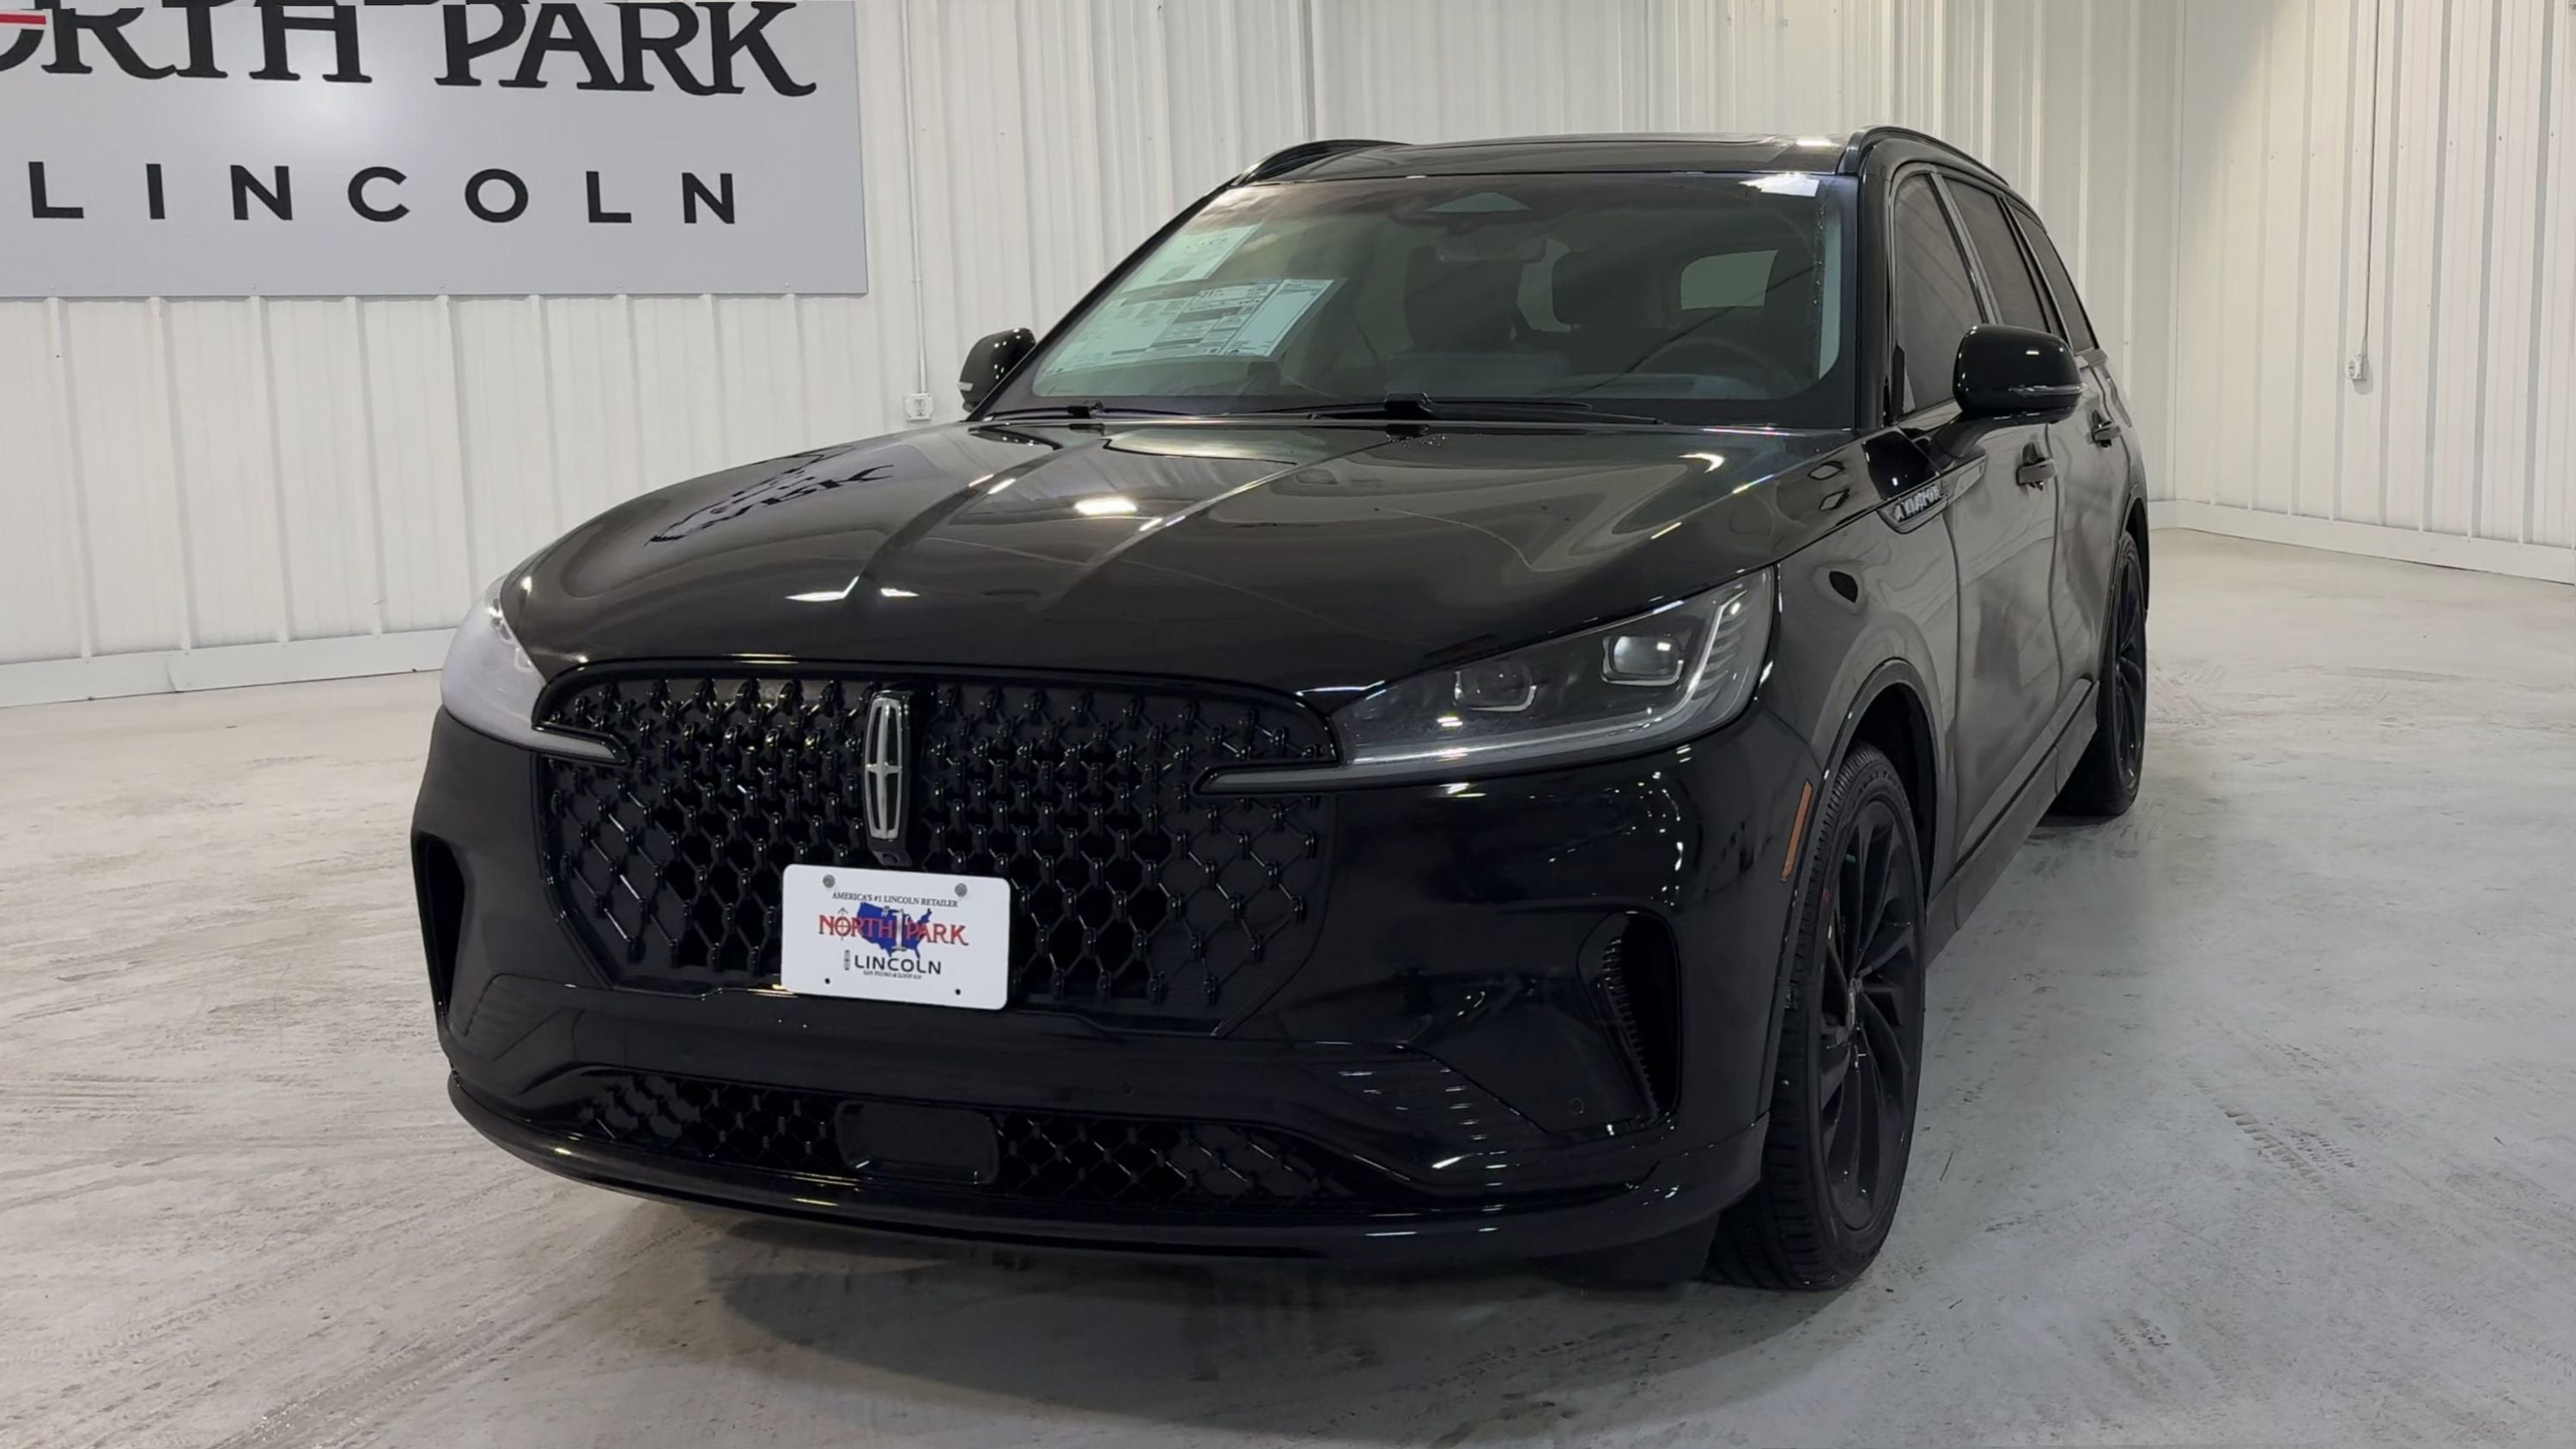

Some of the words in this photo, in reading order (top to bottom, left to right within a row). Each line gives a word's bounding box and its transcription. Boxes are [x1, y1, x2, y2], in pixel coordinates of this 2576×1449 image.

[0, 0, 373, 83] RTH
[434, 0, 817, 97] PARK
[27, 161, 736, 225] LINCOLN
[831, 892, 873, 902] AMERICA'S
[883, 894, 920, 906] LINCOLN
[920, 897, 959, 908] RETAILER
[818, 914, 894, 940] NORTH
[905, 917, 969, 947] PARK
[854, 955, 941, 975] LINCOLN
